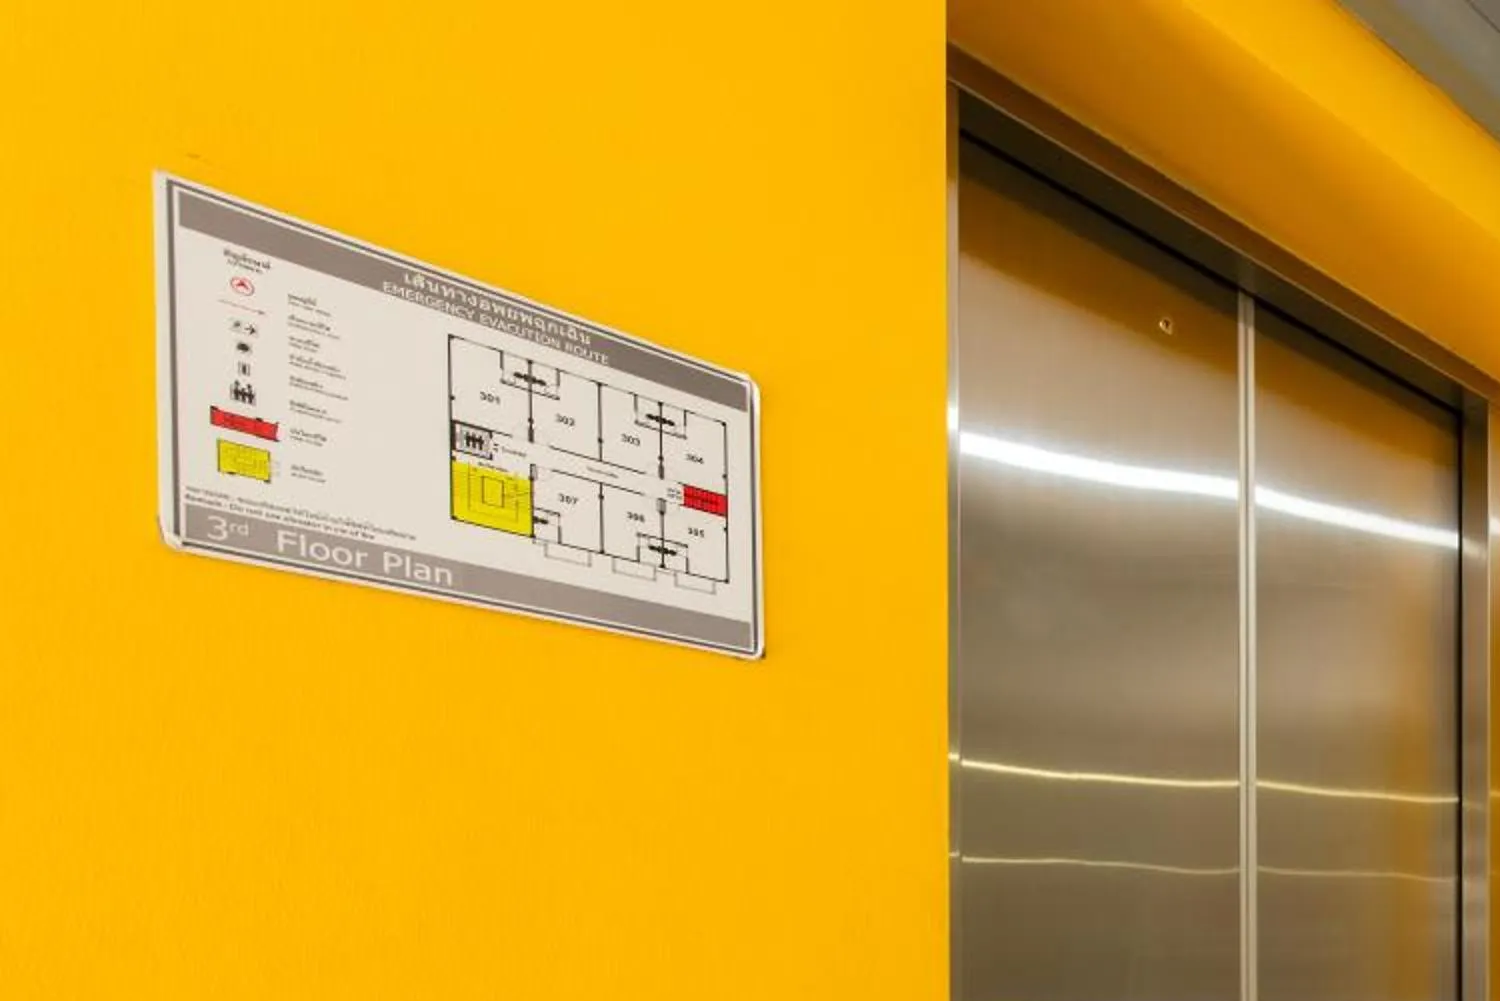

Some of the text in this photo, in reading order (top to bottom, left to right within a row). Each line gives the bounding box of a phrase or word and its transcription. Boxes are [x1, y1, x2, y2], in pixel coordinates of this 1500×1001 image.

[383, 281, 475, 319] EMERGENCY
[564, 344, 609, 365] ROUTE
[480, 391, 500, 405] 301
[556, 413, 576, 427] 302
[621, 433, 641, 447] 303
[207, 515, 249, 541] 3rd
[276, 529, 368, 569] Floor
[382, 551, 453, 586] Plan
